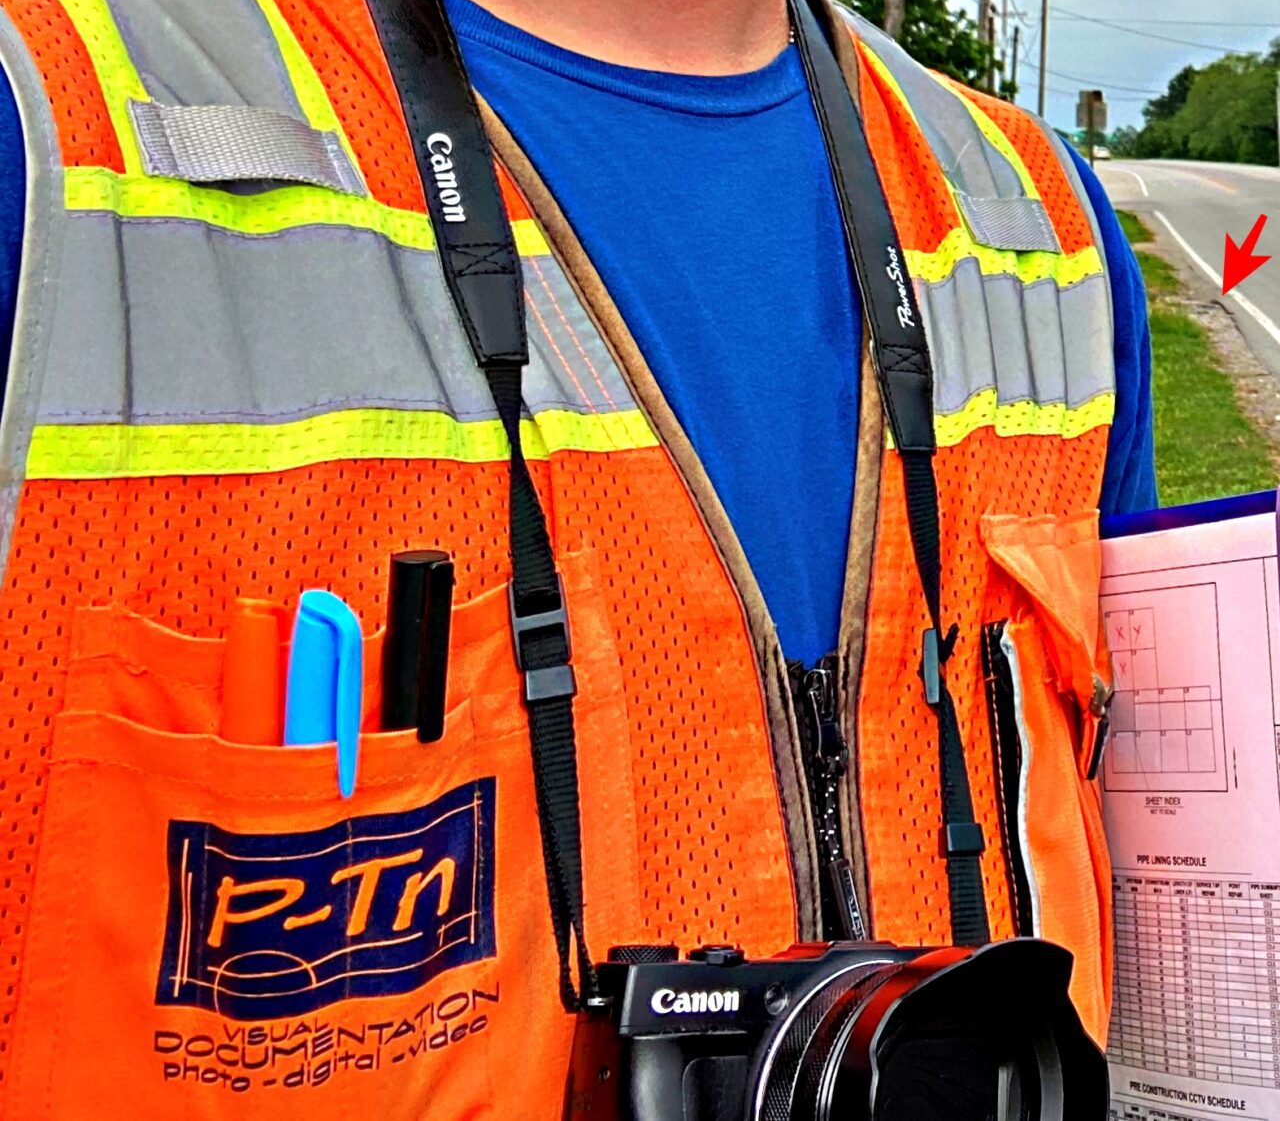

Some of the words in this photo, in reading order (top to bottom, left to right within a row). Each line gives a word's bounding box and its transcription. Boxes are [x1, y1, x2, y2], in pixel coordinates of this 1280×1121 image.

[427, 133, 467, 222] Canon
[886, 245, 915, 328] PowerShot
[1164, 796, 1182, 806] INDEX
[1136, 854, 1150, 865] PIPE
[1151, 855, 1171, 866] LINING
[1172, 855, 1207, 867] SCHEDULE
[207, 848, 456, 948] P-Tn
[153, 981, 500, 1070] DOCUMENTATION
[650, 988, 740, 1015] Canon
[162, 1057, 251, 1093] photo
[282, 1048, 381, 1087] digital
[408, 1014, 488, 1058] video
[223, 1021, 329, 1045] VISUAL
[1129, 1081, 1142, 1092] PRE
[1142, 1083, 1188, 1102] CONSTRUCTION
[1189, 1092, 1206, 1104] CCTV
[1207, 1095, 1246, 1111] SCHEDULE
